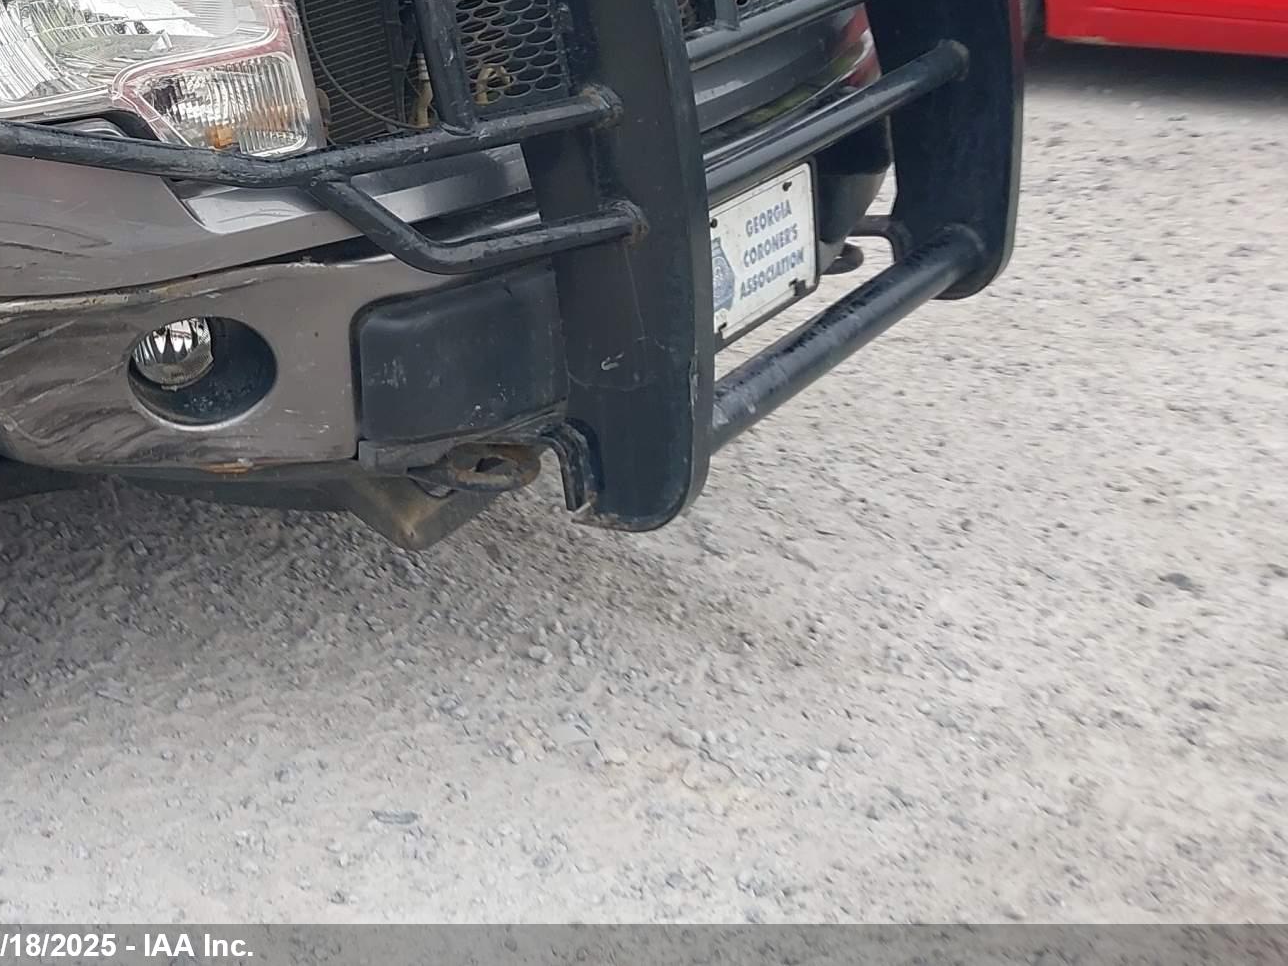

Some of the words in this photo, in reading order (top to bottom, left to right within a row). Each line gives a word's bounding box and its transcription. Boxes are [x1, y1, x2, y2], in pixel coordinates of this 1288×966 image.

[745, 200, 792, 237] GEORGIA
[743, 222, 799, 268] CORONER'S
[740, 247, 805, 301] ASSOCIATION
